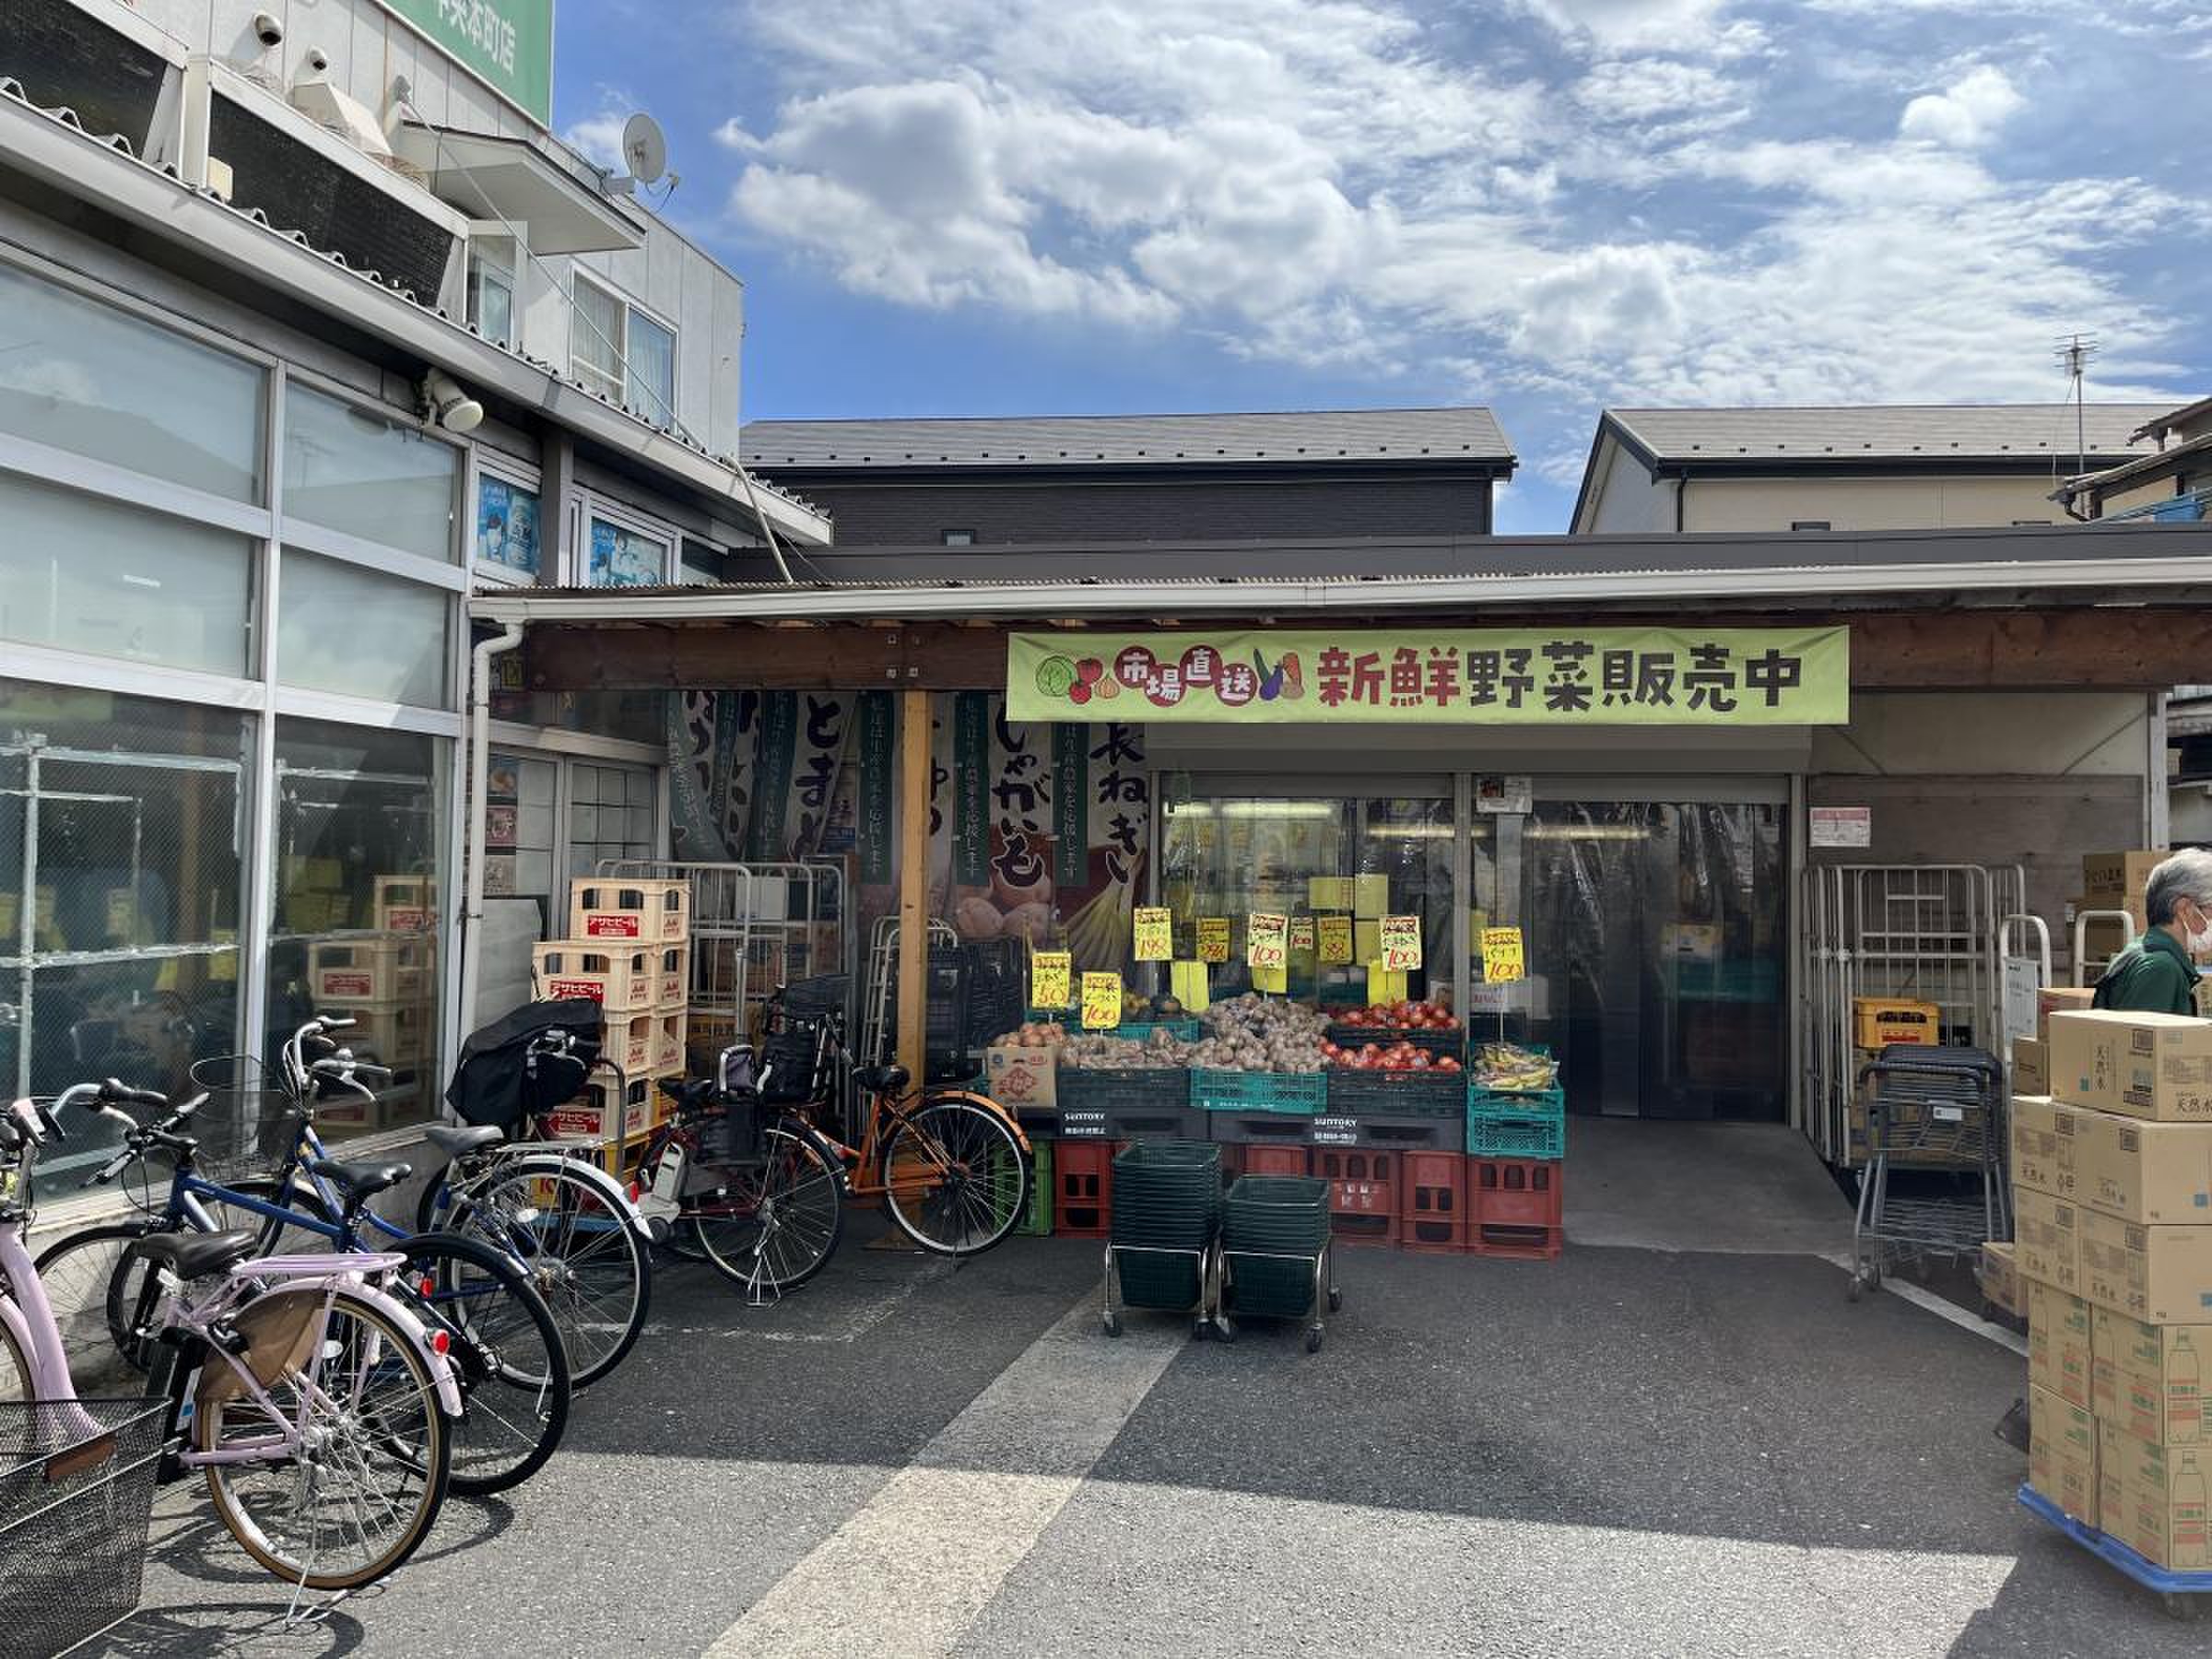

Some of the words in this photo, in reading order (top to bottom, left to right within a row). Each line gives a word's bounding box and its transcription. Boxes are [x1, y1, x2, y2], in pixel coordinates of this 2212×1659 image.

[439, 0, 516, 76] 央本町店
[1123, 649, 1252, 702] 市場直送
[1317, 641, 1801, 712] 新鮮野菜販売中
